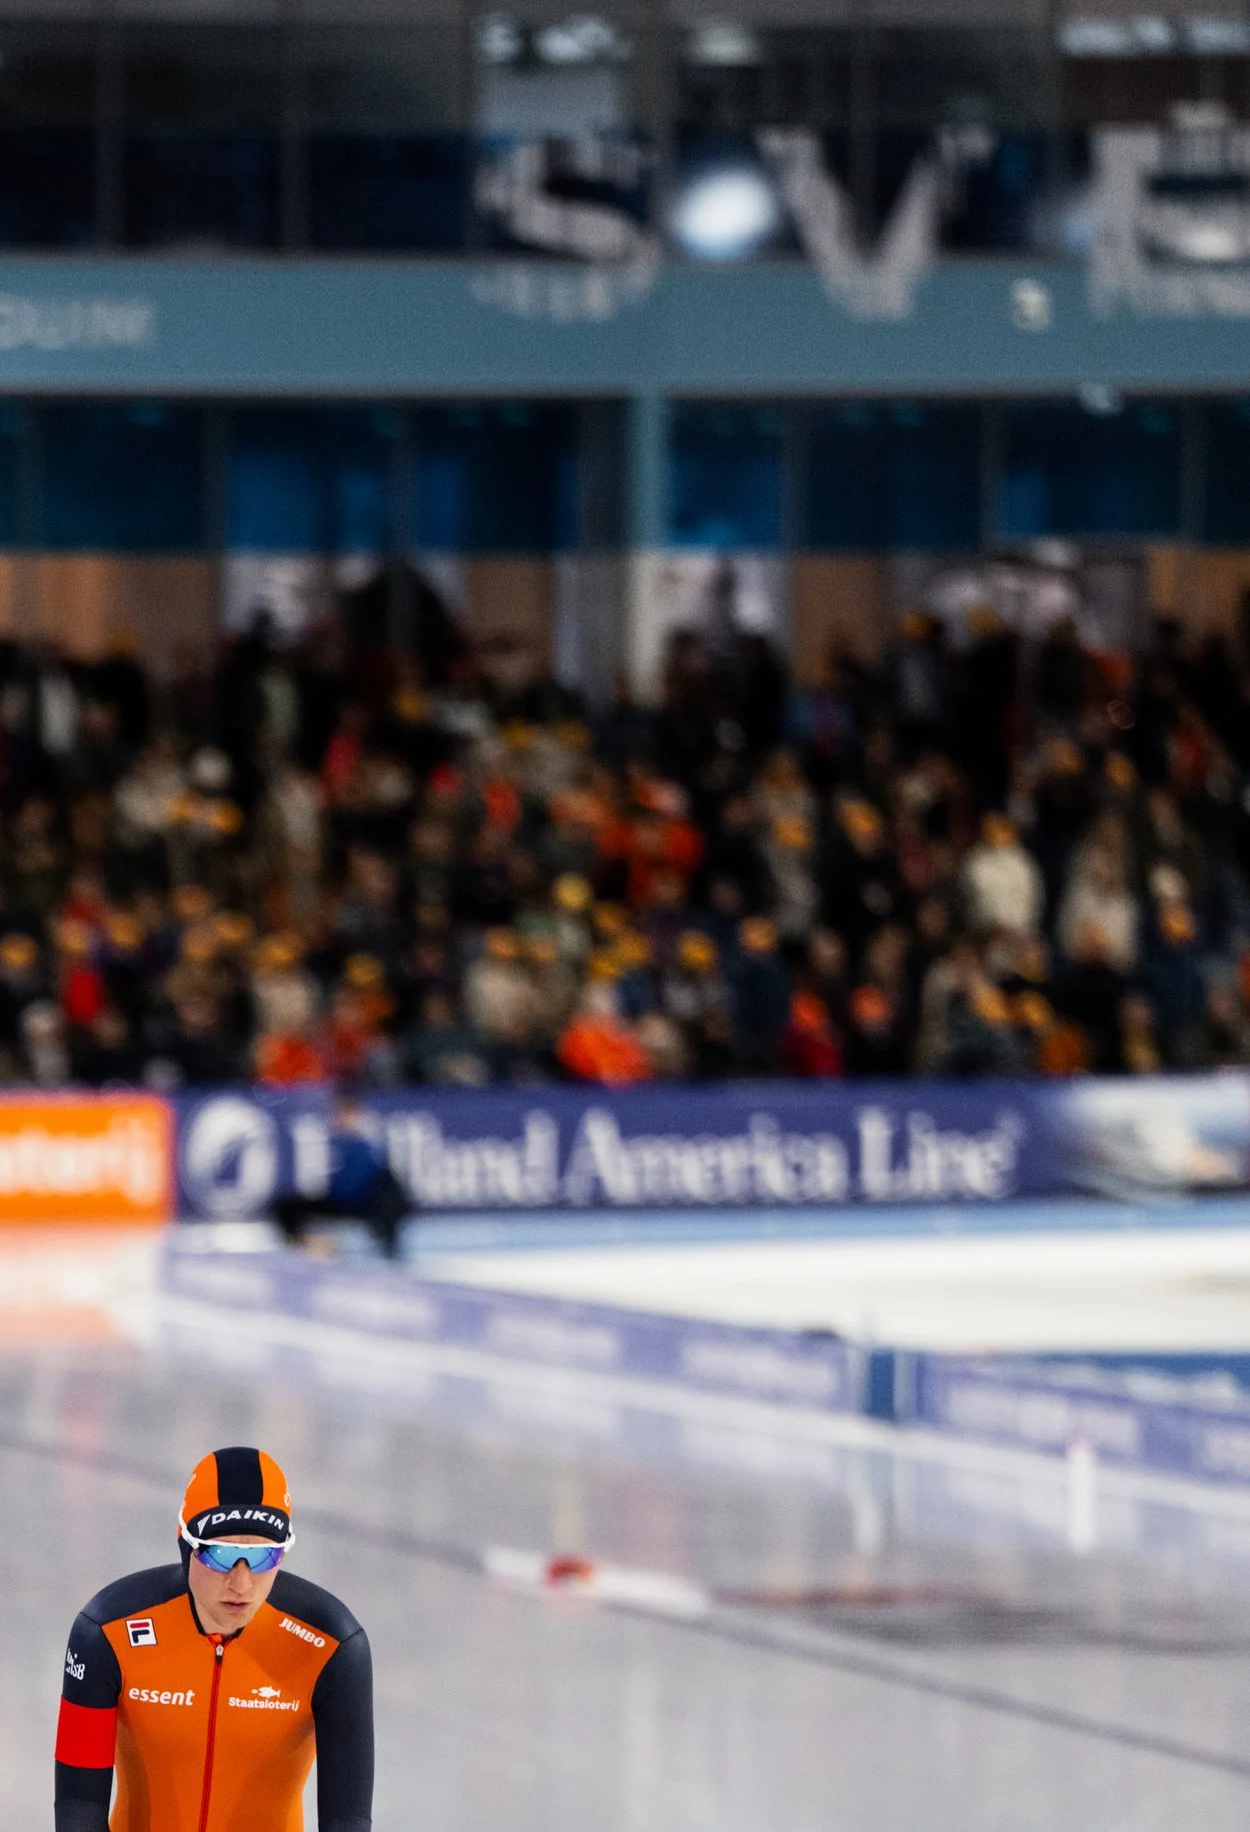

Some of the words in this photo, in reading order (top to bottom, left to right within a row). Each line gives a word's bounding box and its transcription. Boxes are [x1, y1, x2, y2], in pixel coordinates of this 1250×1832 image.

[564, 1106, 849, 1206] America
[855, 1104, 1020, 1201] Line
[212, 1509, 285, 1531] DAIKIN
[278, 1617, 326, 1648] JUMBO
[128, 1687, 196, 1706] essent
[228, 1696, 300, 1712] Staatsloterij
